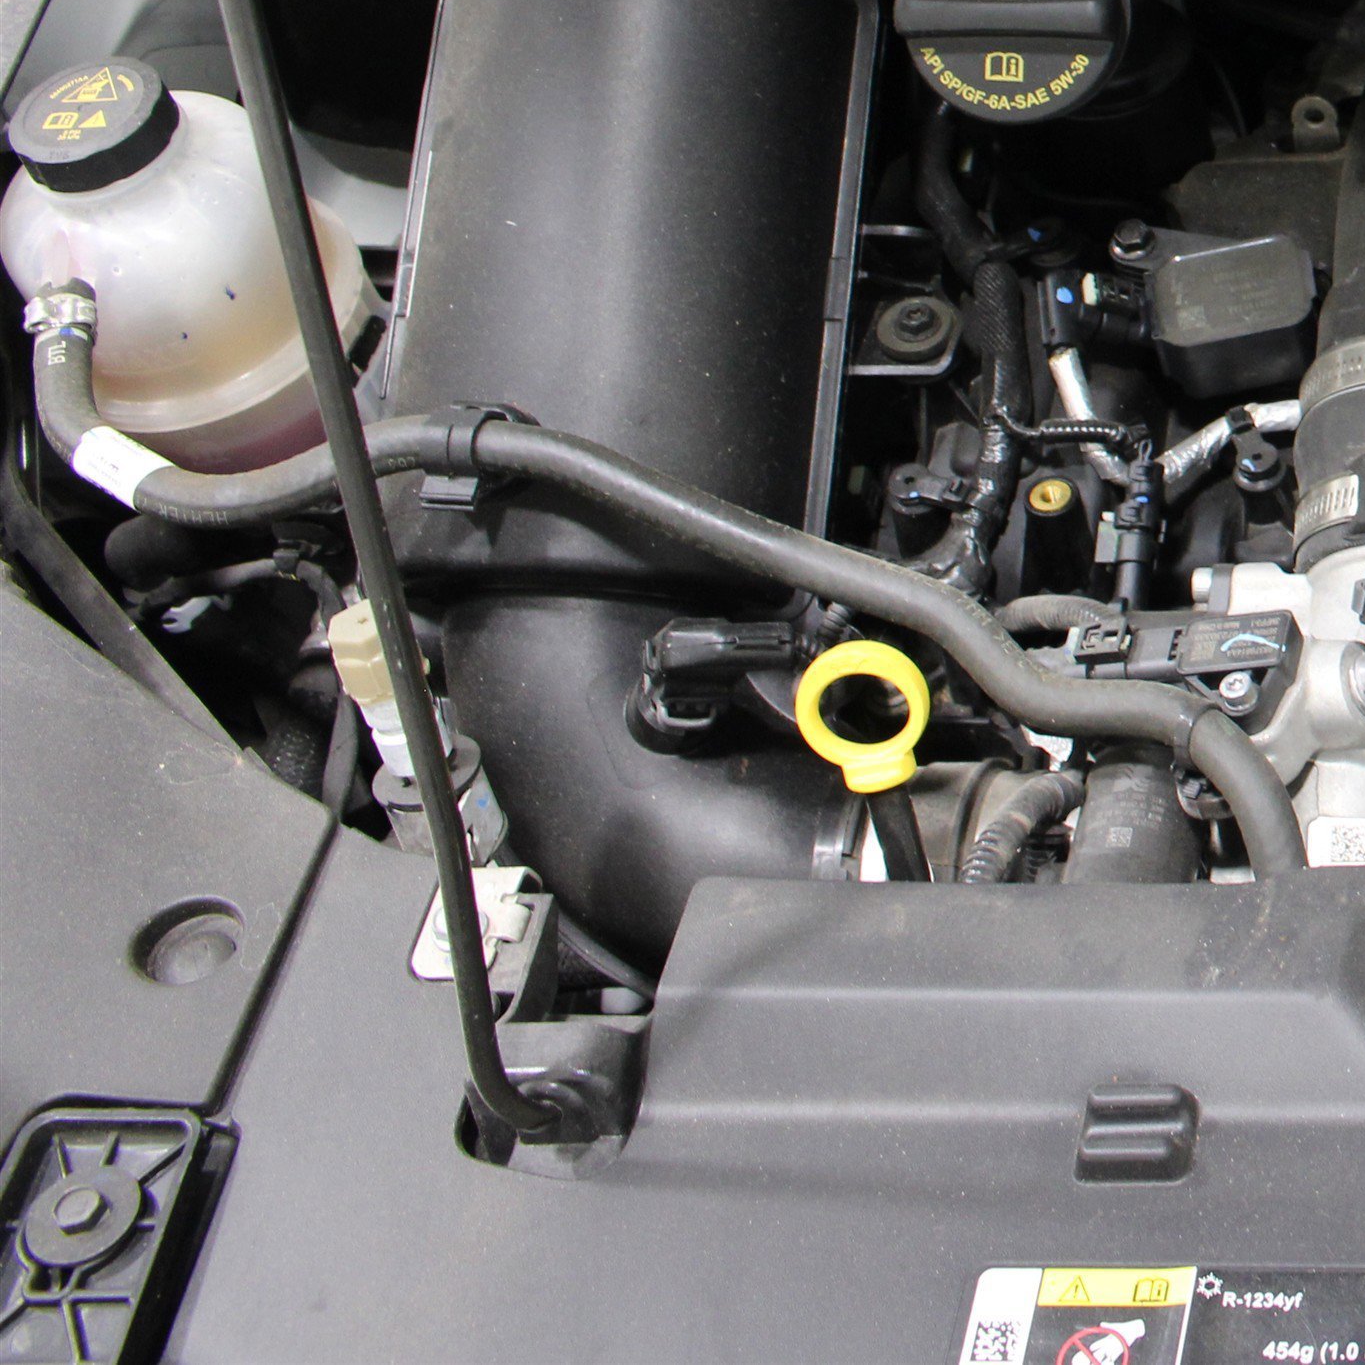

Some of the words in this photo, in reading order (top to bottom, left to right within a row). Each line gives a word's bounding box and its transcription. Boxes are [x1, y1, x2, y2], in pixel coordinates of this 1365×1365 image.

[920, 47, 945, 75] API
[939, 70, 1050, 111] SP/GF-6A-SAE
[1049, 53, 1090, 96] 5W-30
[47, 340, 66, 365] BTL
[1222, 1291, 1304, 1312] R-1234yf
[1262, 1341, 1315, 1364] 454g
[1320, 1341, 1360, 1364] (1.0
